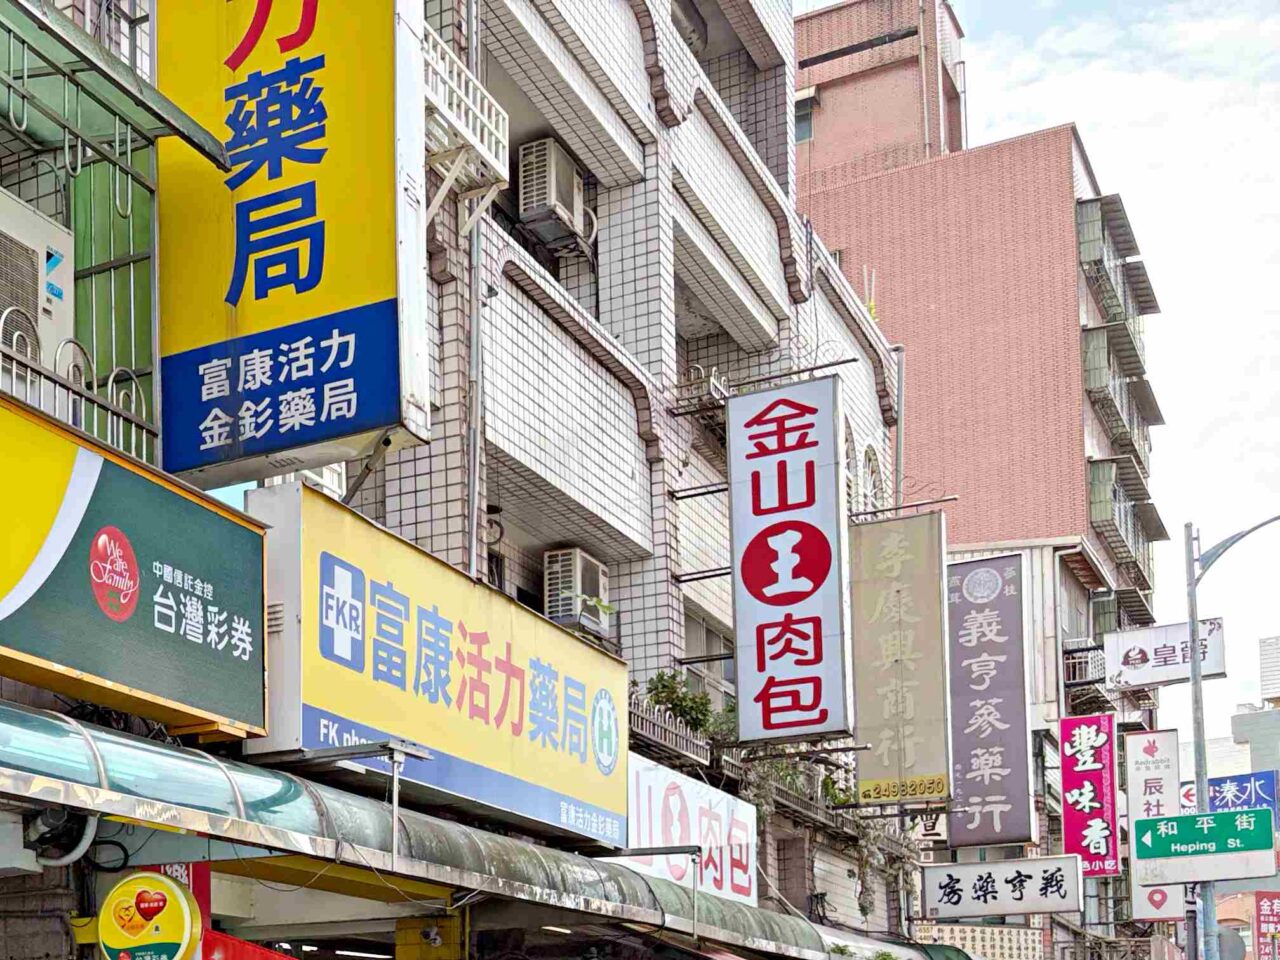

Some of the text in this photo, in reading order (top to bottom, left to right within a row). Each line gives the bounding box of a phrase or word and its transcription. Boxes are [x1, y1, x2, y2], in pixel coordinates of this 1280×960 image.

[198, 328, 357, 402] 富康活力
[152, 560, 214, 601] 中國信託金控
[152, 583, 254, 661] 台灣彩券
[369, 579, 588, 764] 富康活力藥局
[319, 717, 340, 748] FK
[1156, 813, 1256, 838] 和平街
[1170, 838, 1245, 853] Heping St.
